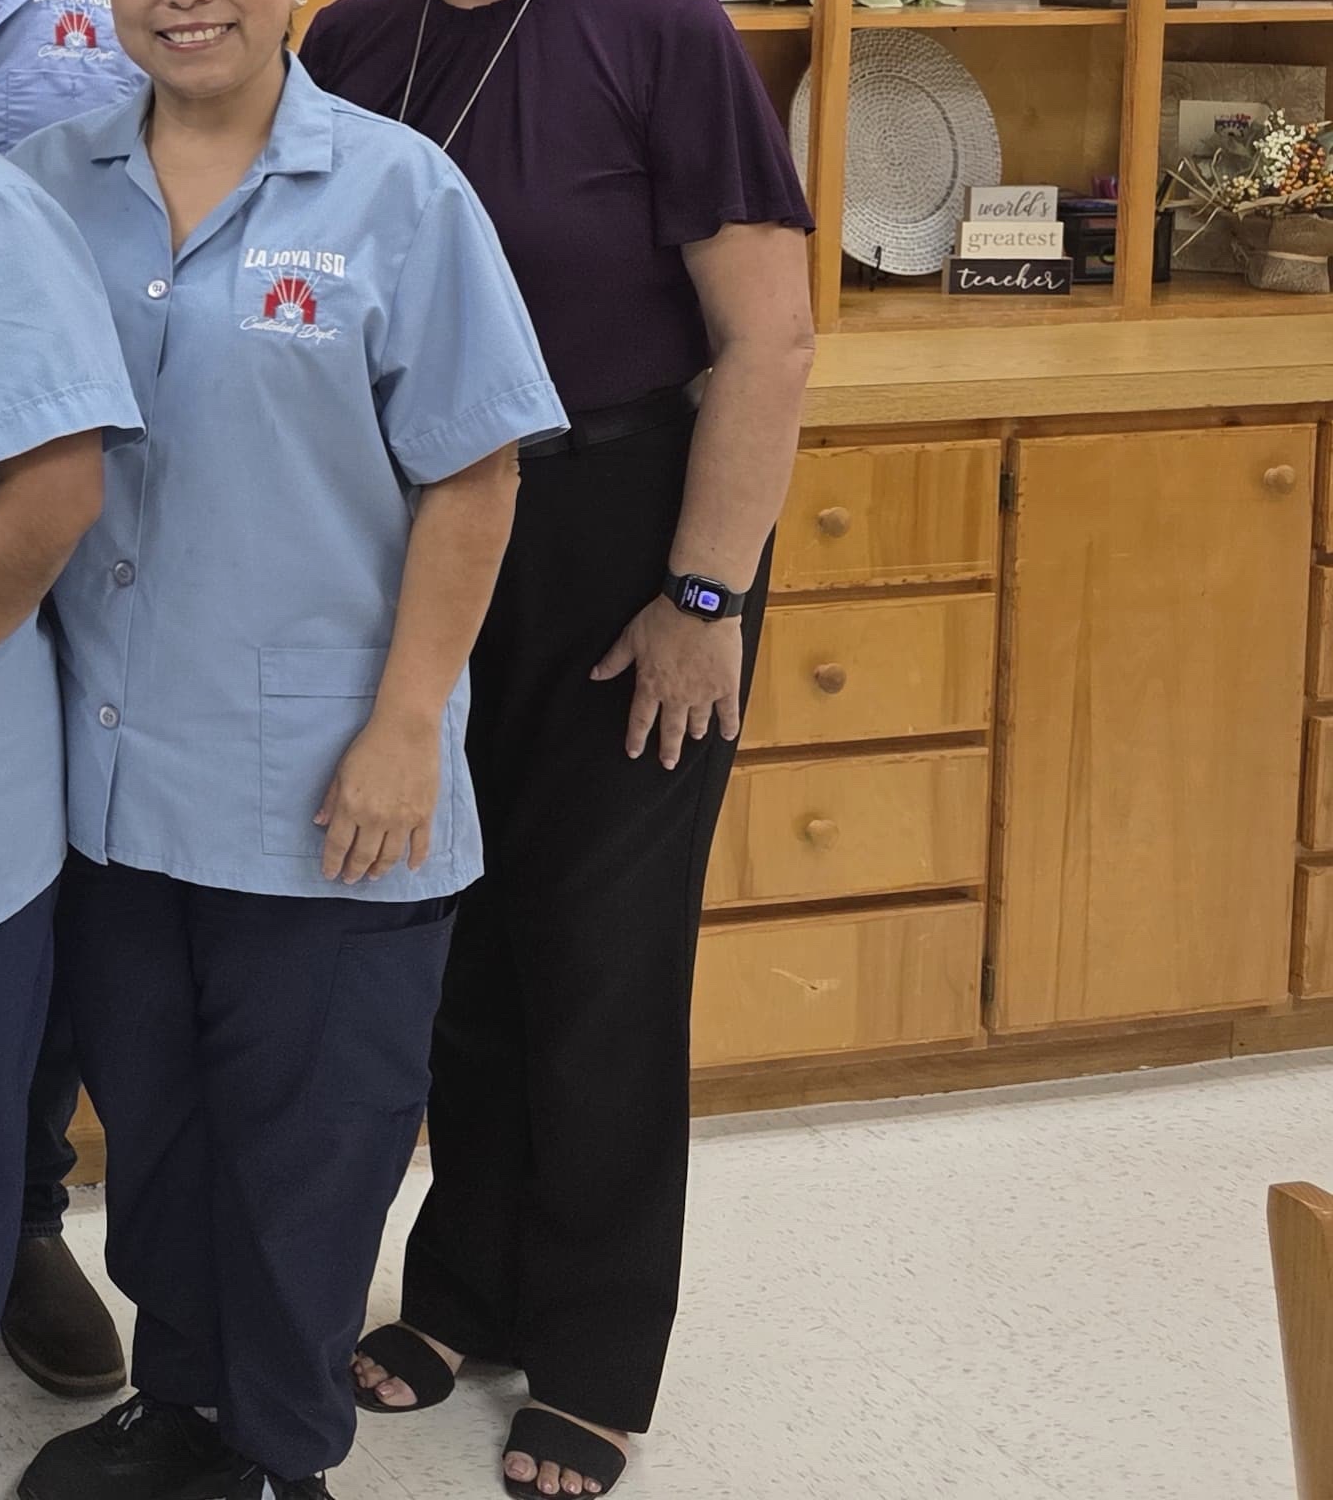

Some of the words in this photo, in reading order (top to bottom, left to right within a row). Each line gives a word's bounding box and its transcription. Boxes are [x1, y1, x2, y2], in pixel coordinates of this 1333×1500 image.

[977, 190, 1052, 217] world's
[967, 231, 1058, 253] greatest
[244, 248, 267, 268] LA
[268, 250, 311, 269] JOYA
[315, 251, 345, 278] ISD
[957, 263, 1065, 290] teacher
[239, 315, 299, 334] Custodial
